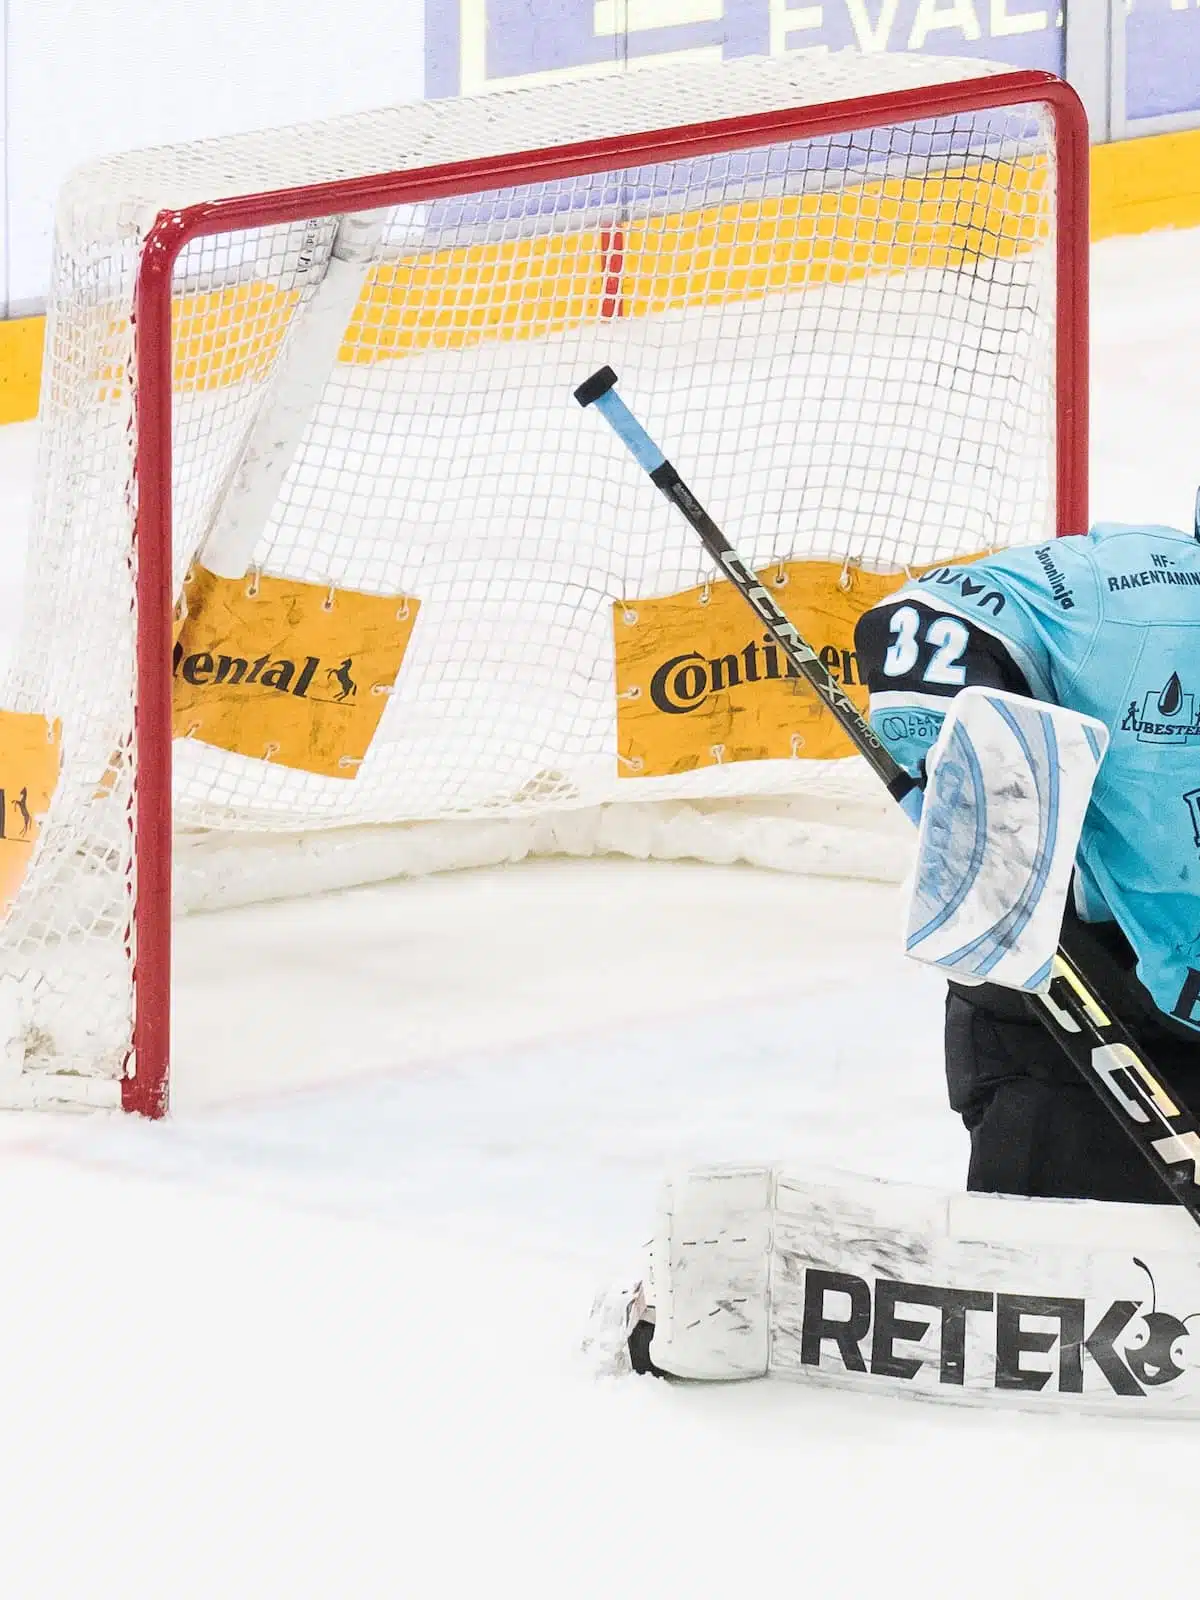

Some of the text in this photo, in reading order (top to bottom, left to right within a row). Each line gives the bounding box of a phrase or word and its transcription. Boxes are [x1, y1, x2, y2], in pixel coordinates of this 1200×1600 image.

[1034, 547, 1075, 610] Savonlinja
[1150, 553, 1175, 568] HF-
[720, 550, 818, 663] CCM
[173, 641, 320, 698] ental
[883, 605, 970, 686] 32
[800, 1267, 1147, 1398] RETEK
